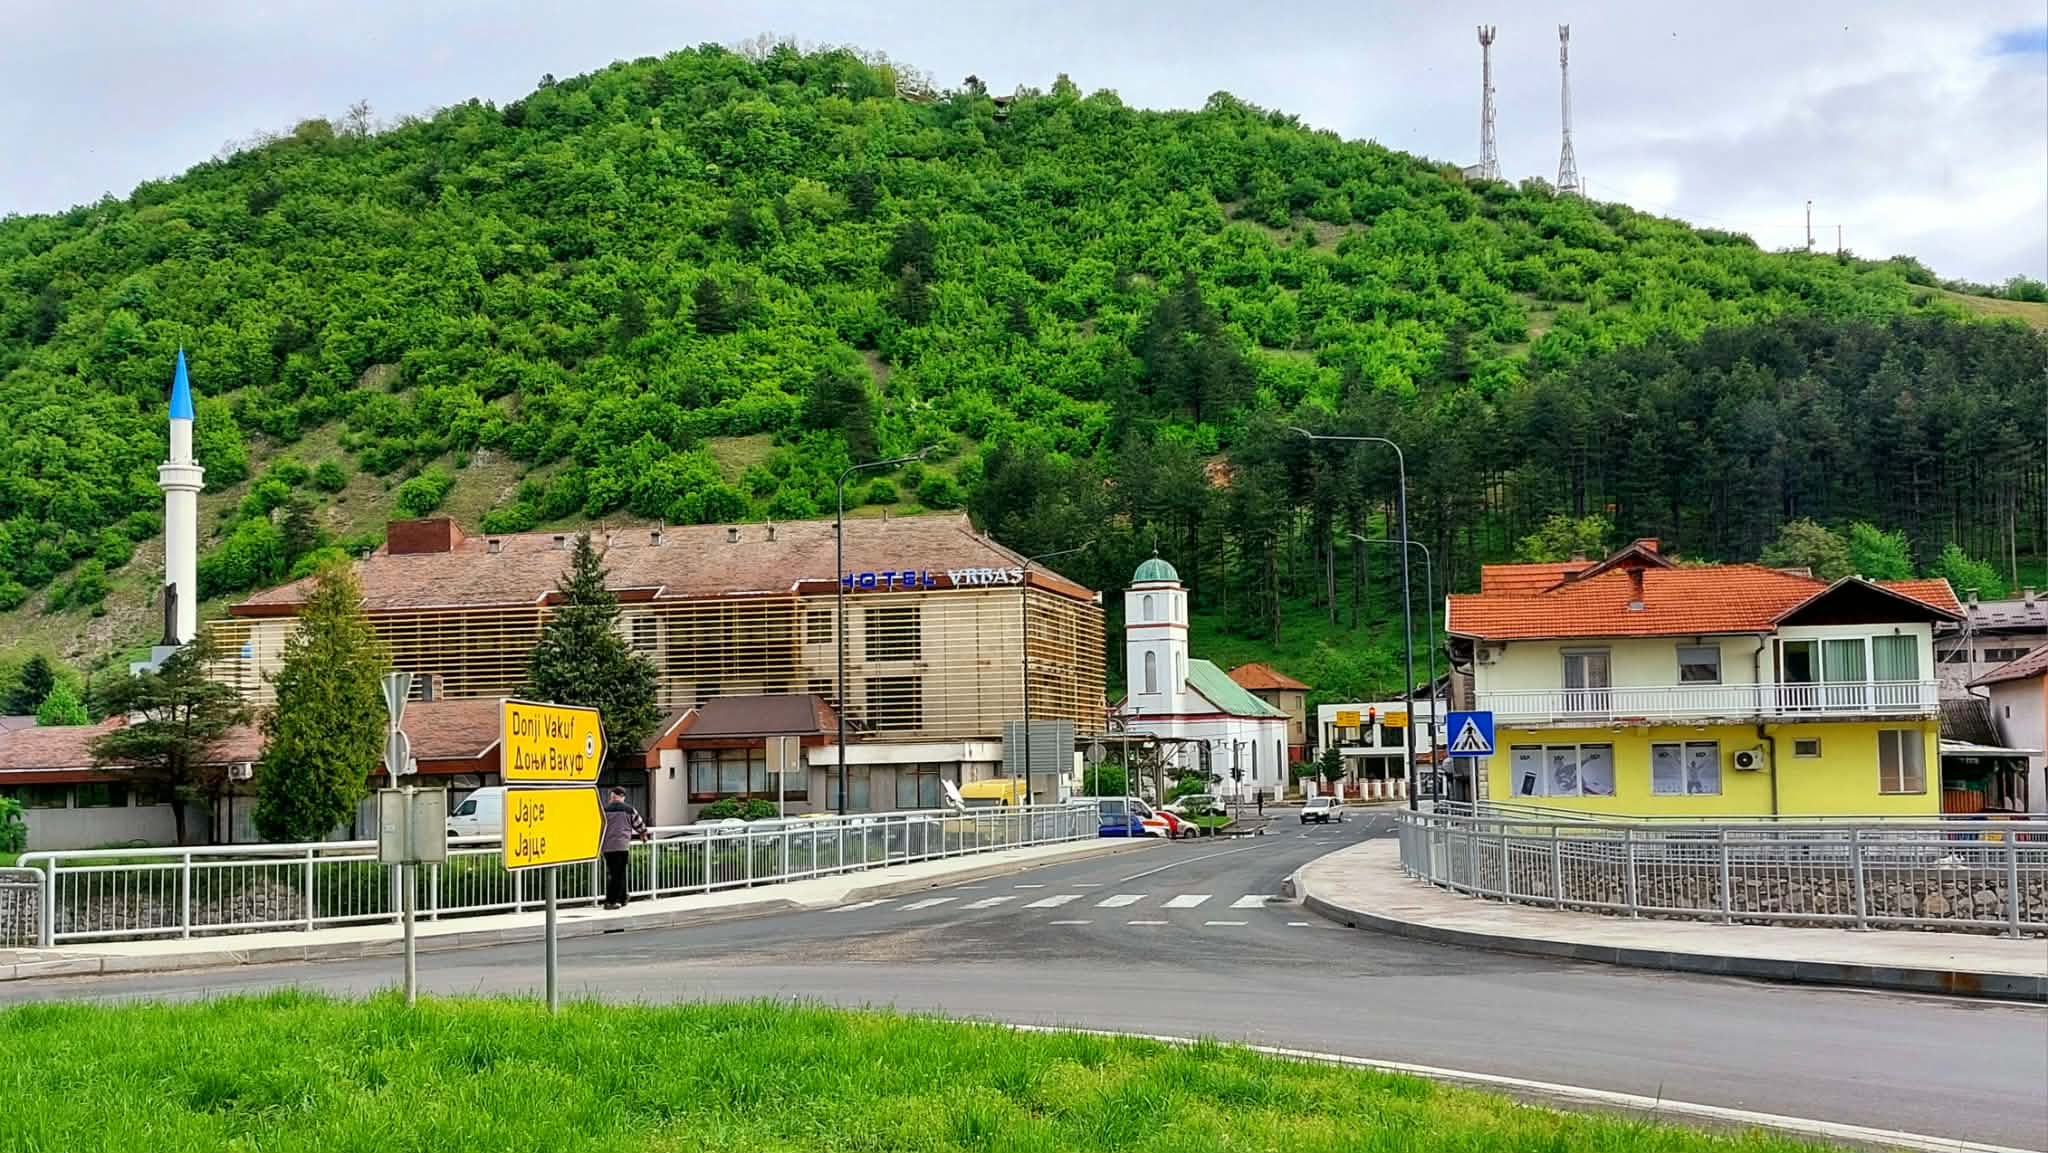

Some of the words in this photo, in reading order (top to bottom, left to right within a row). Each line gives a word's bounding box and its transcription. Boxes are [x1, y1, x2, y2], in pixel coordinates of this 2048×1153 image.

[840, 569, 936, 589] HOTEL
[947, 567, 1024, 586] VRBAS
[513, 711, 541, 743] Donji
[544, 714, 576, 740] Vakuf
[514, 746, 547, 771] Доњи
[549, 747, 584, 776] Вакуф
[515, 797, 545, 828] Jajce
[515, 832, 546, 862] Јајце
